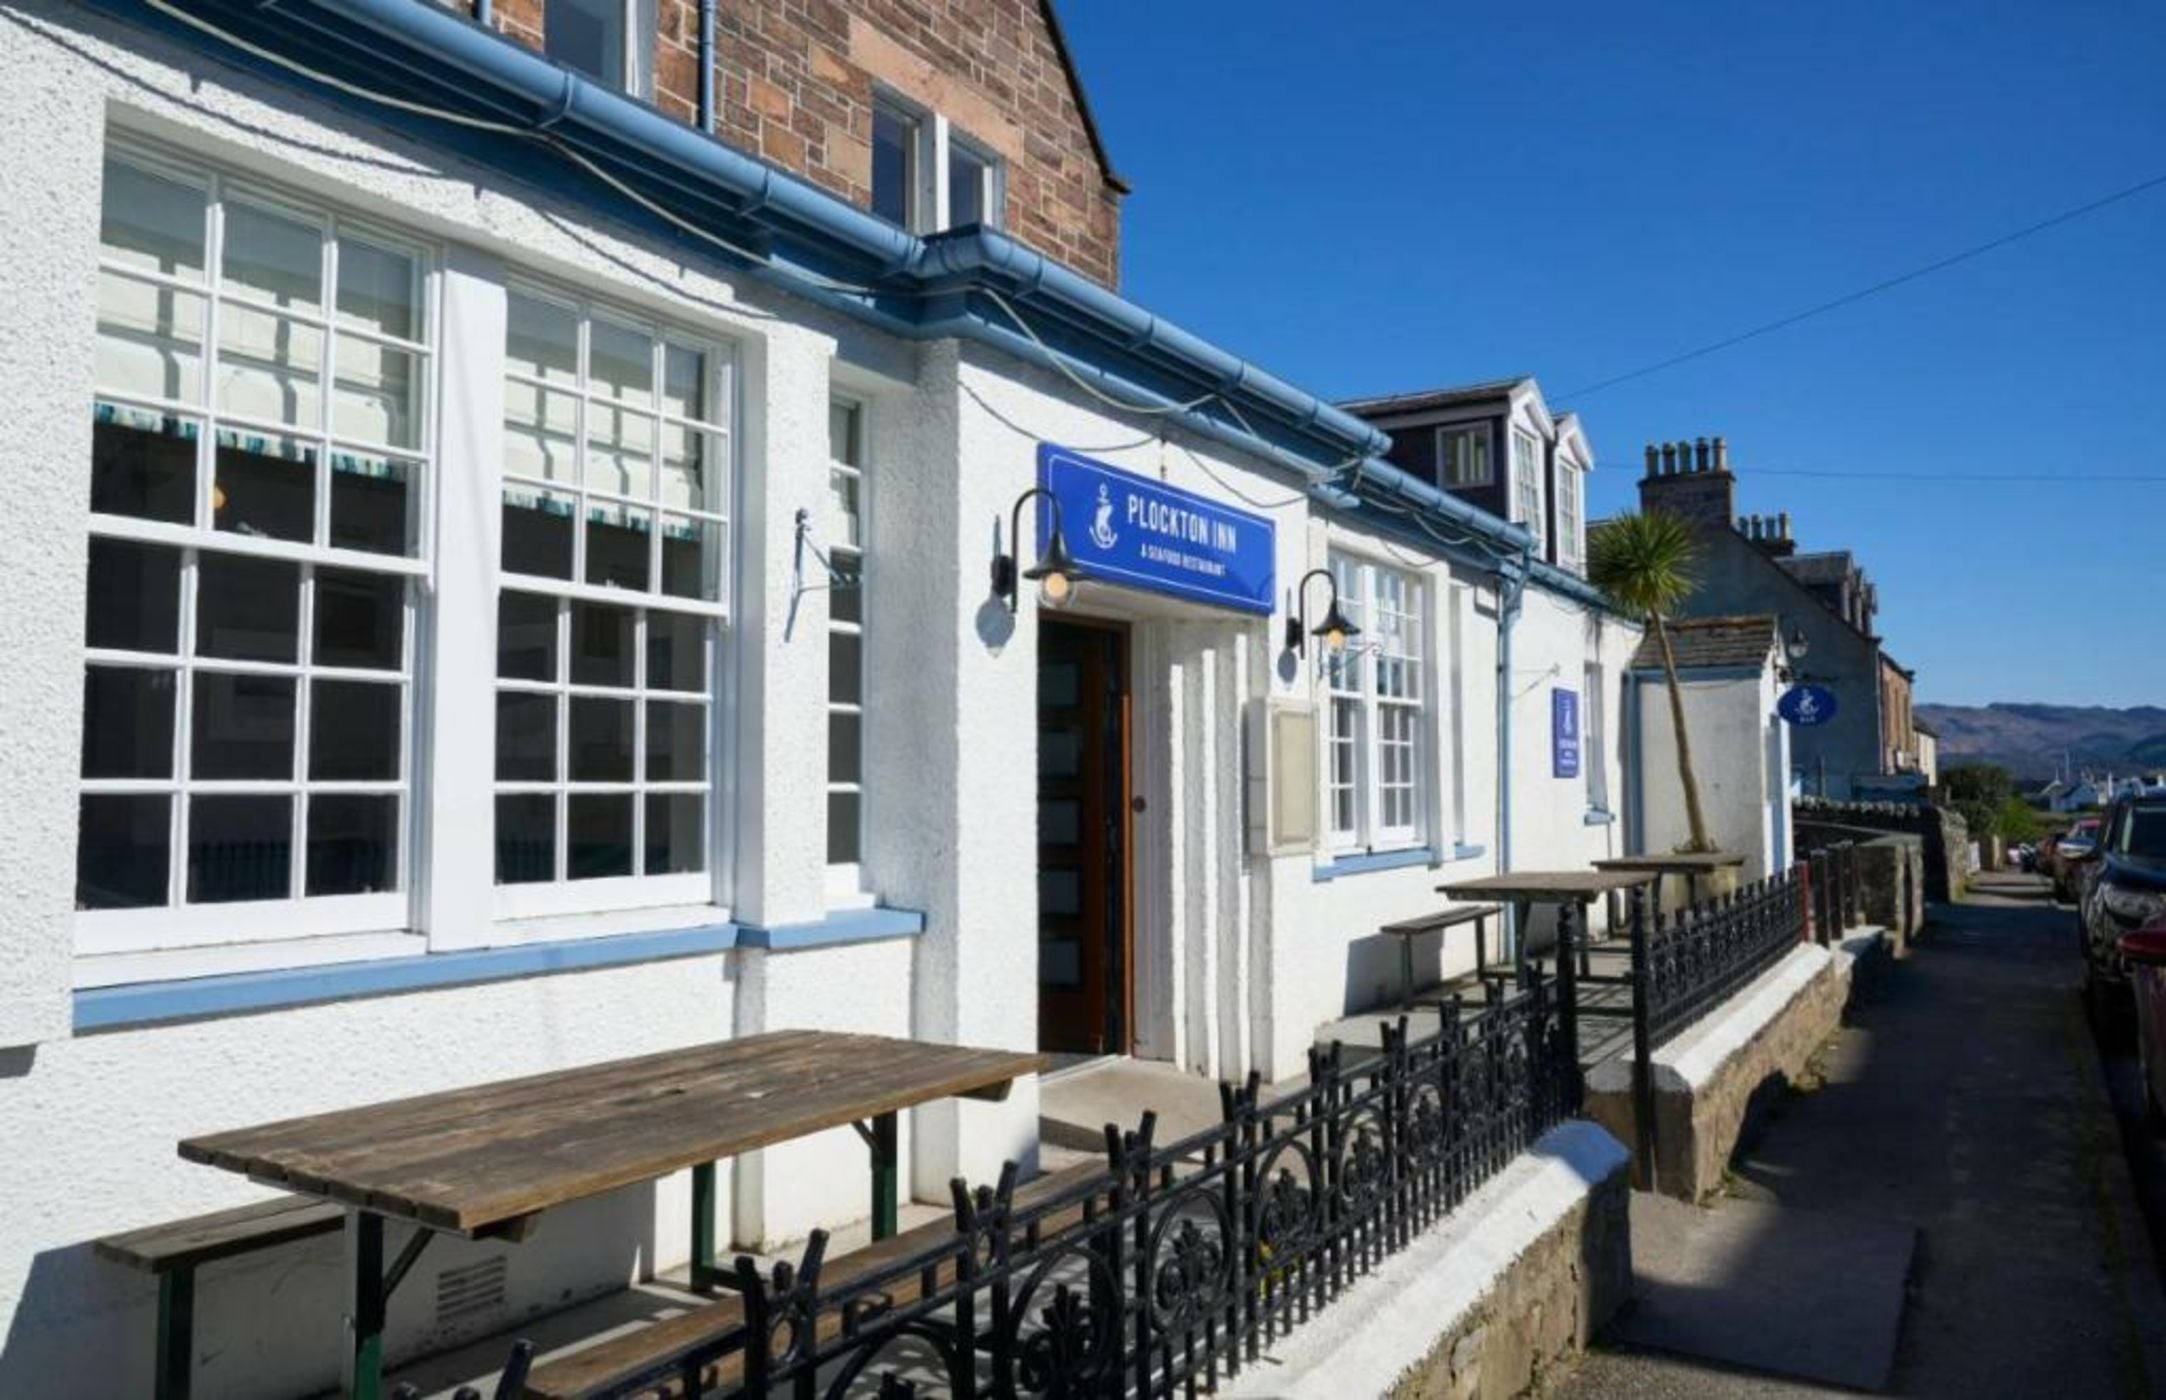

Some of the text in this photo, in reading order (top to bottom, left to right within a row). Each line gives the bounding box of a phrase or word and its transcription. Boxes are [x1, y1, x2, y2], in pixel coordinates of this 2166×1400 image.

[1128, 494, 1236, 555] PLOCKTON INN
[1182, 554, 1226, 577] RESTAURANT
